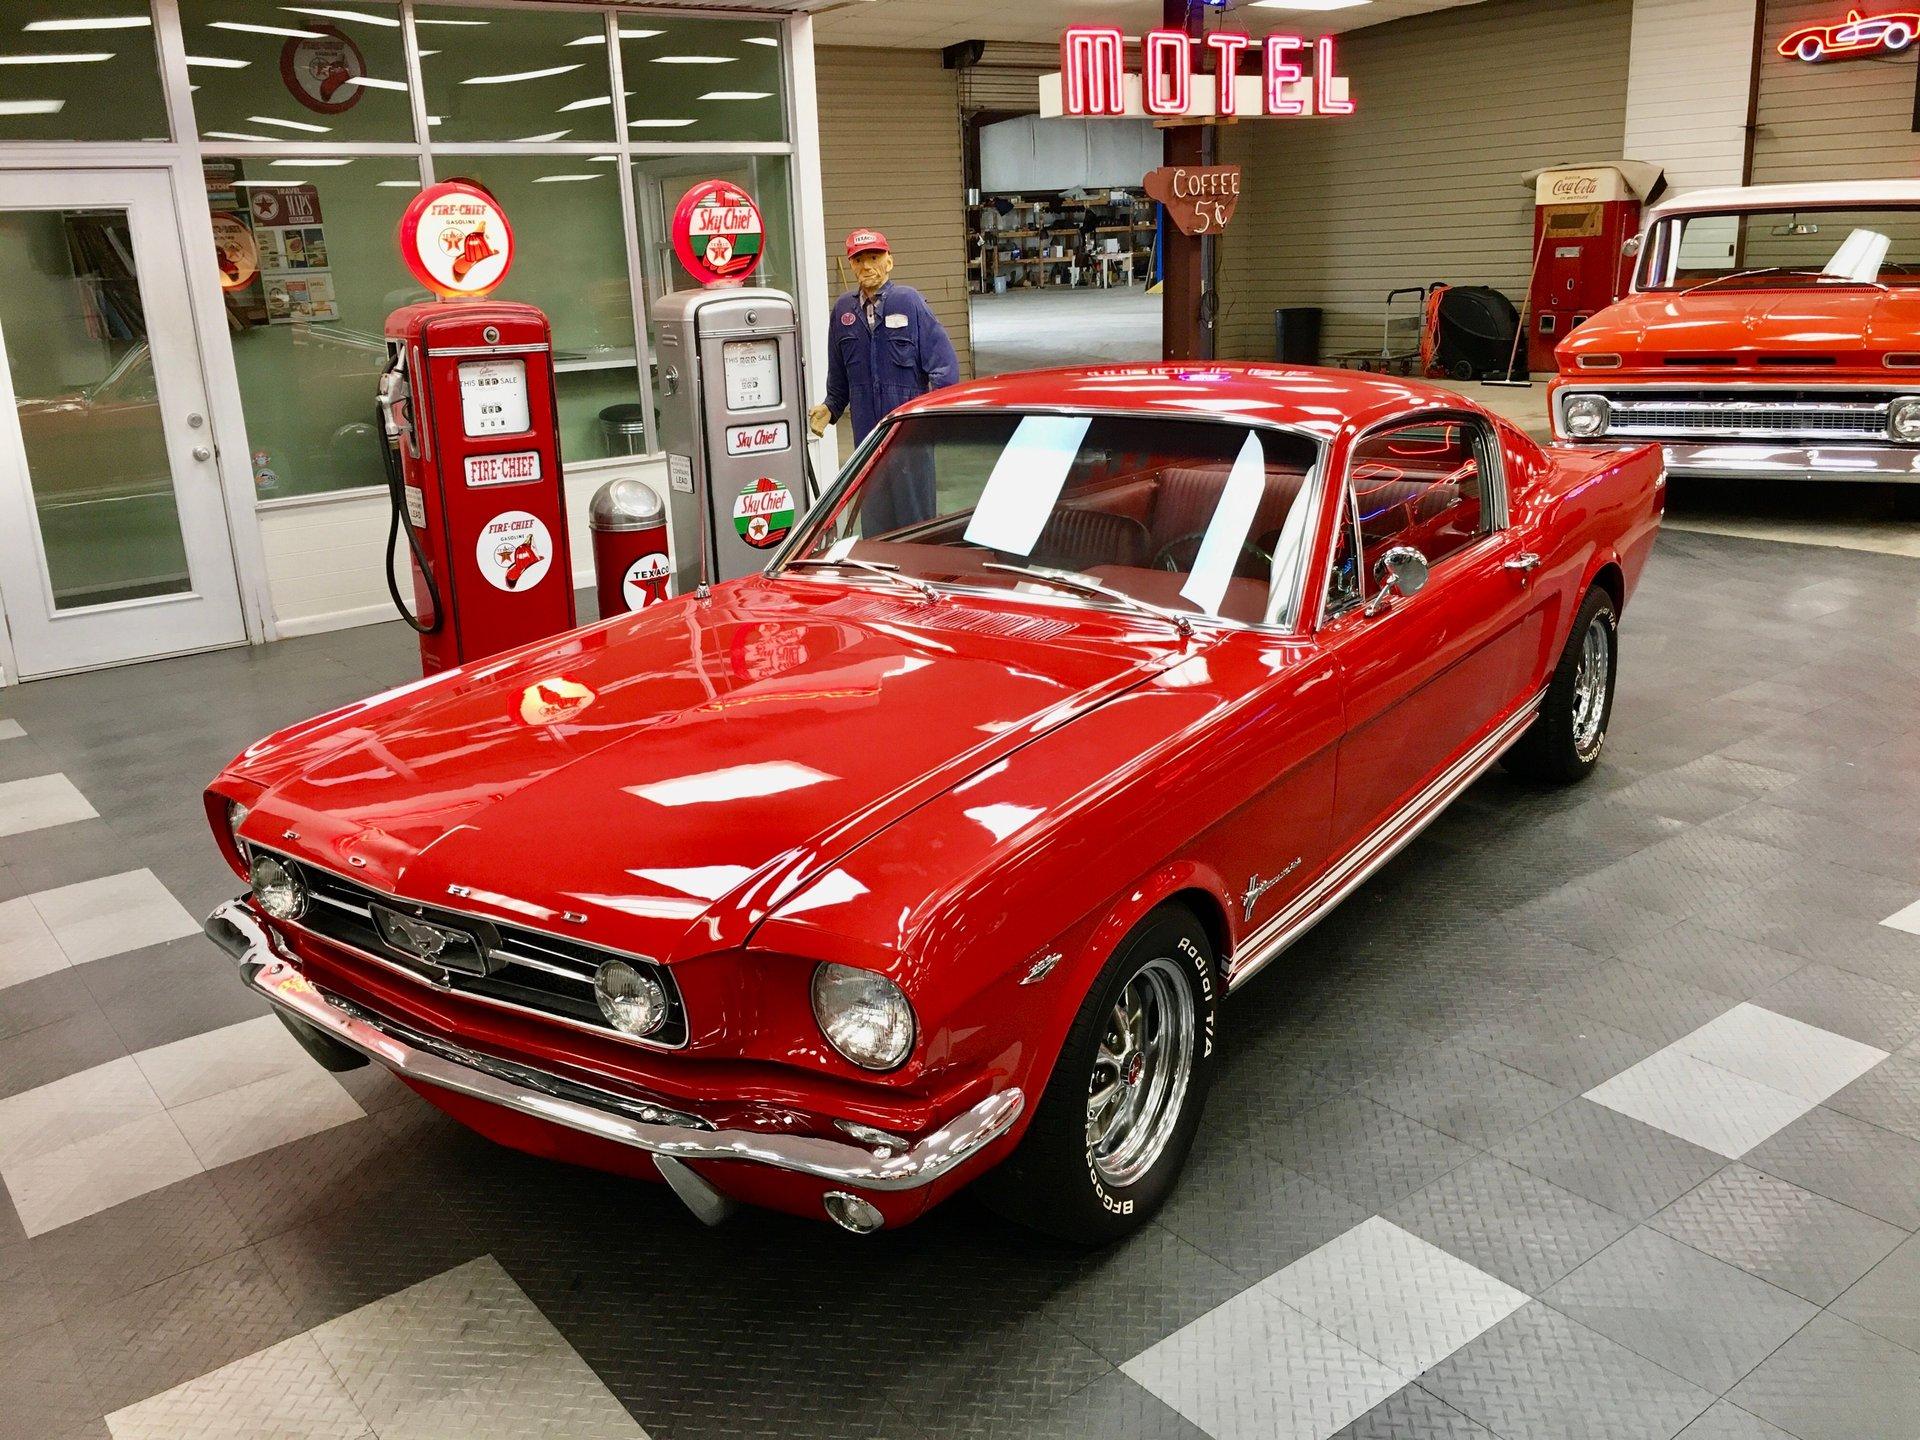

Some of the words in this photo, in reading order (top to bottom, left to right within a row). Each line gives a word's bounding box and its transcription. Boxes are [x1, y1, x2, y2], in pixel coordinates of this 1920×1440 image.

[1062, 27, 1356, 115] MOTEL
[1173, 169, 1240, 198] COFFEE
[1552, 177, 1600, 196] Coca-Cola
[285, 195, 313, 215] MAPS
[431, 204, 487, 216] FIRE-CHIEF
[699, 208, 722, 233] Sky
[724, 207, 752, 230] Chief
[1193, 200, 1228, 233] 5¢
[736, 431, 752, 448] Sky
[754, 428, 778, 446] Chief
[470, 455, 535, 482] FIRE-CHIEF
[741, 495, 760, 514] Sky
[760, 490, 786, 511] Chief
[489, 518, 535, 534] FIRE-CHIEF
[500, 533, 525, 542] GASOLINE
[633, 565, 670, 580] TEXACO
[1203, 1010, 1214, 1058] T/A
